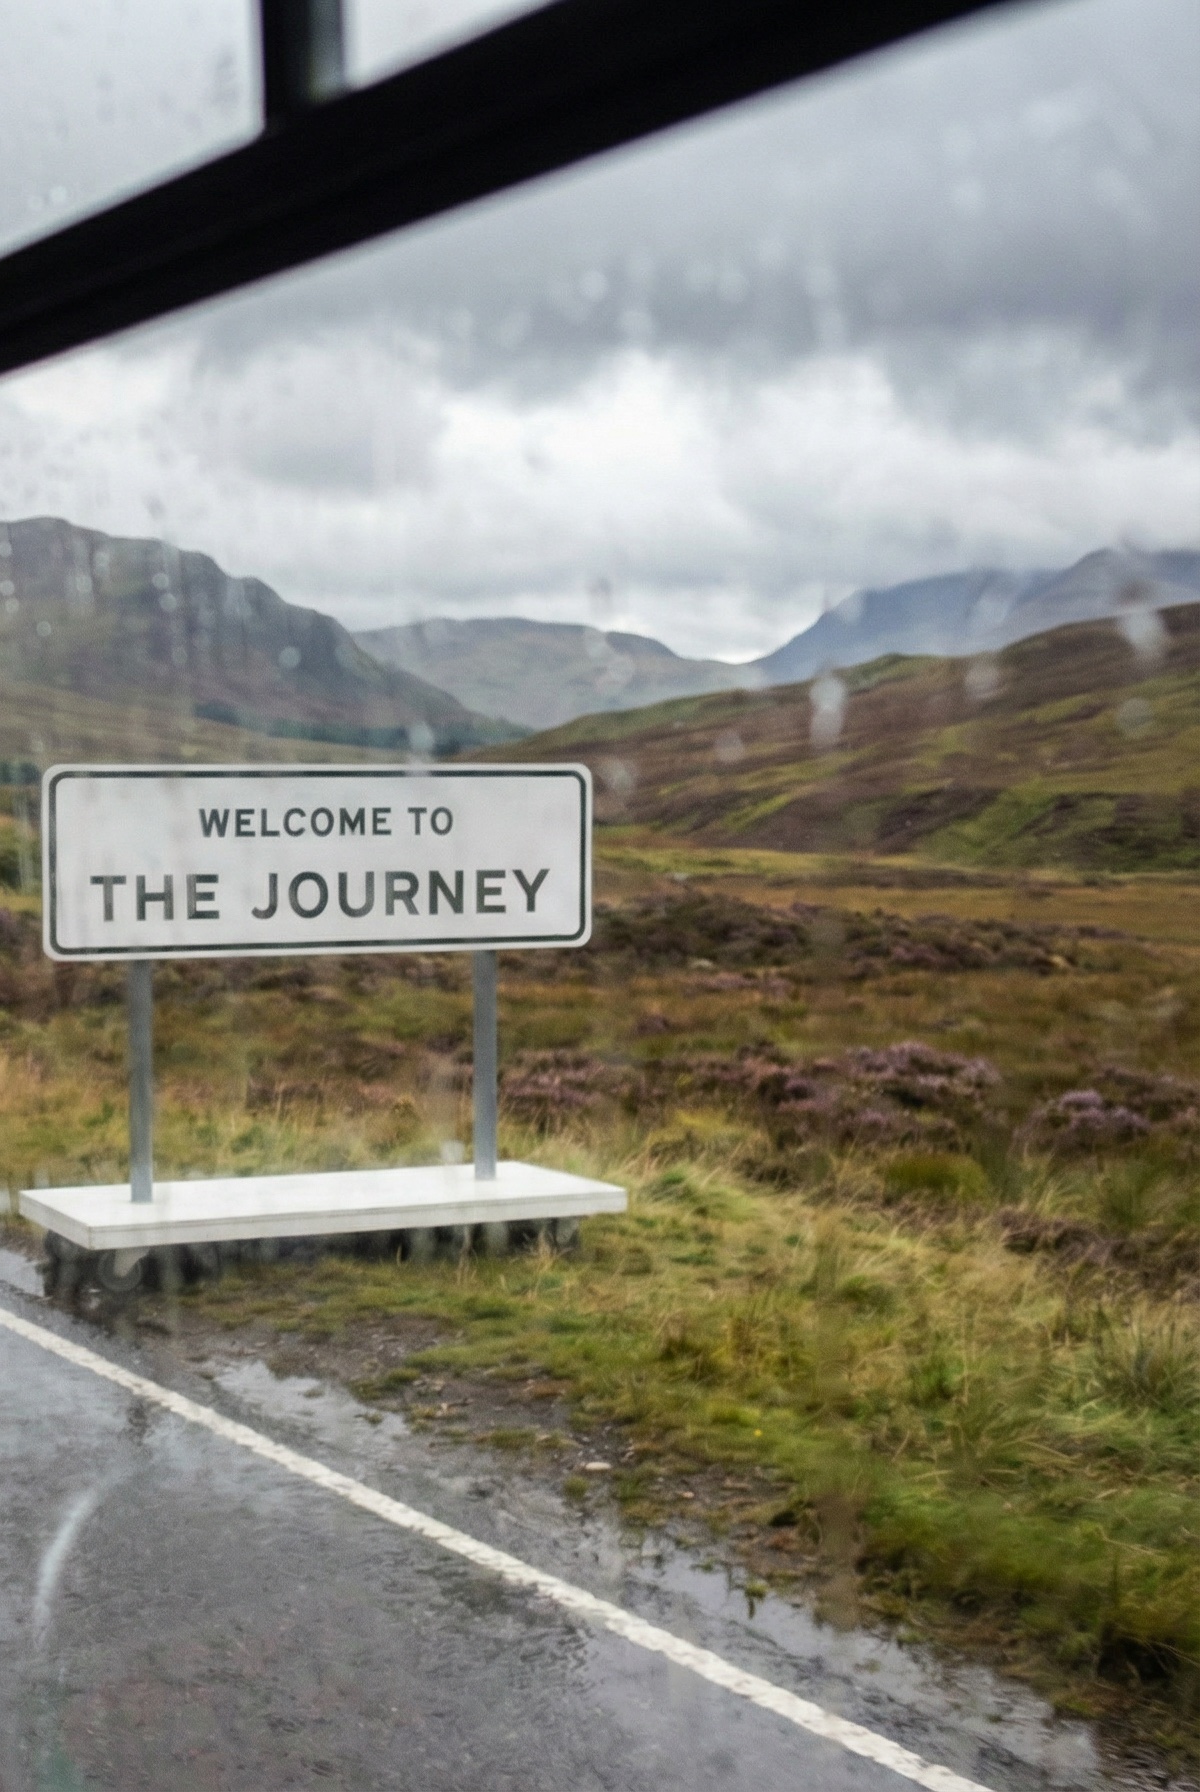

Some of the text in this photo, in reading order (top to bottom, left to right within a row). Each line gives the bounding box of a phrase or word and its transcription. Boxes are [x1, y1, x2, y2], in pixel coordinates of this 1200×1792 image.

[198, 806, 454, 838] WELCOME TO
[90, 868, 551, 922] THE JOURNEY
